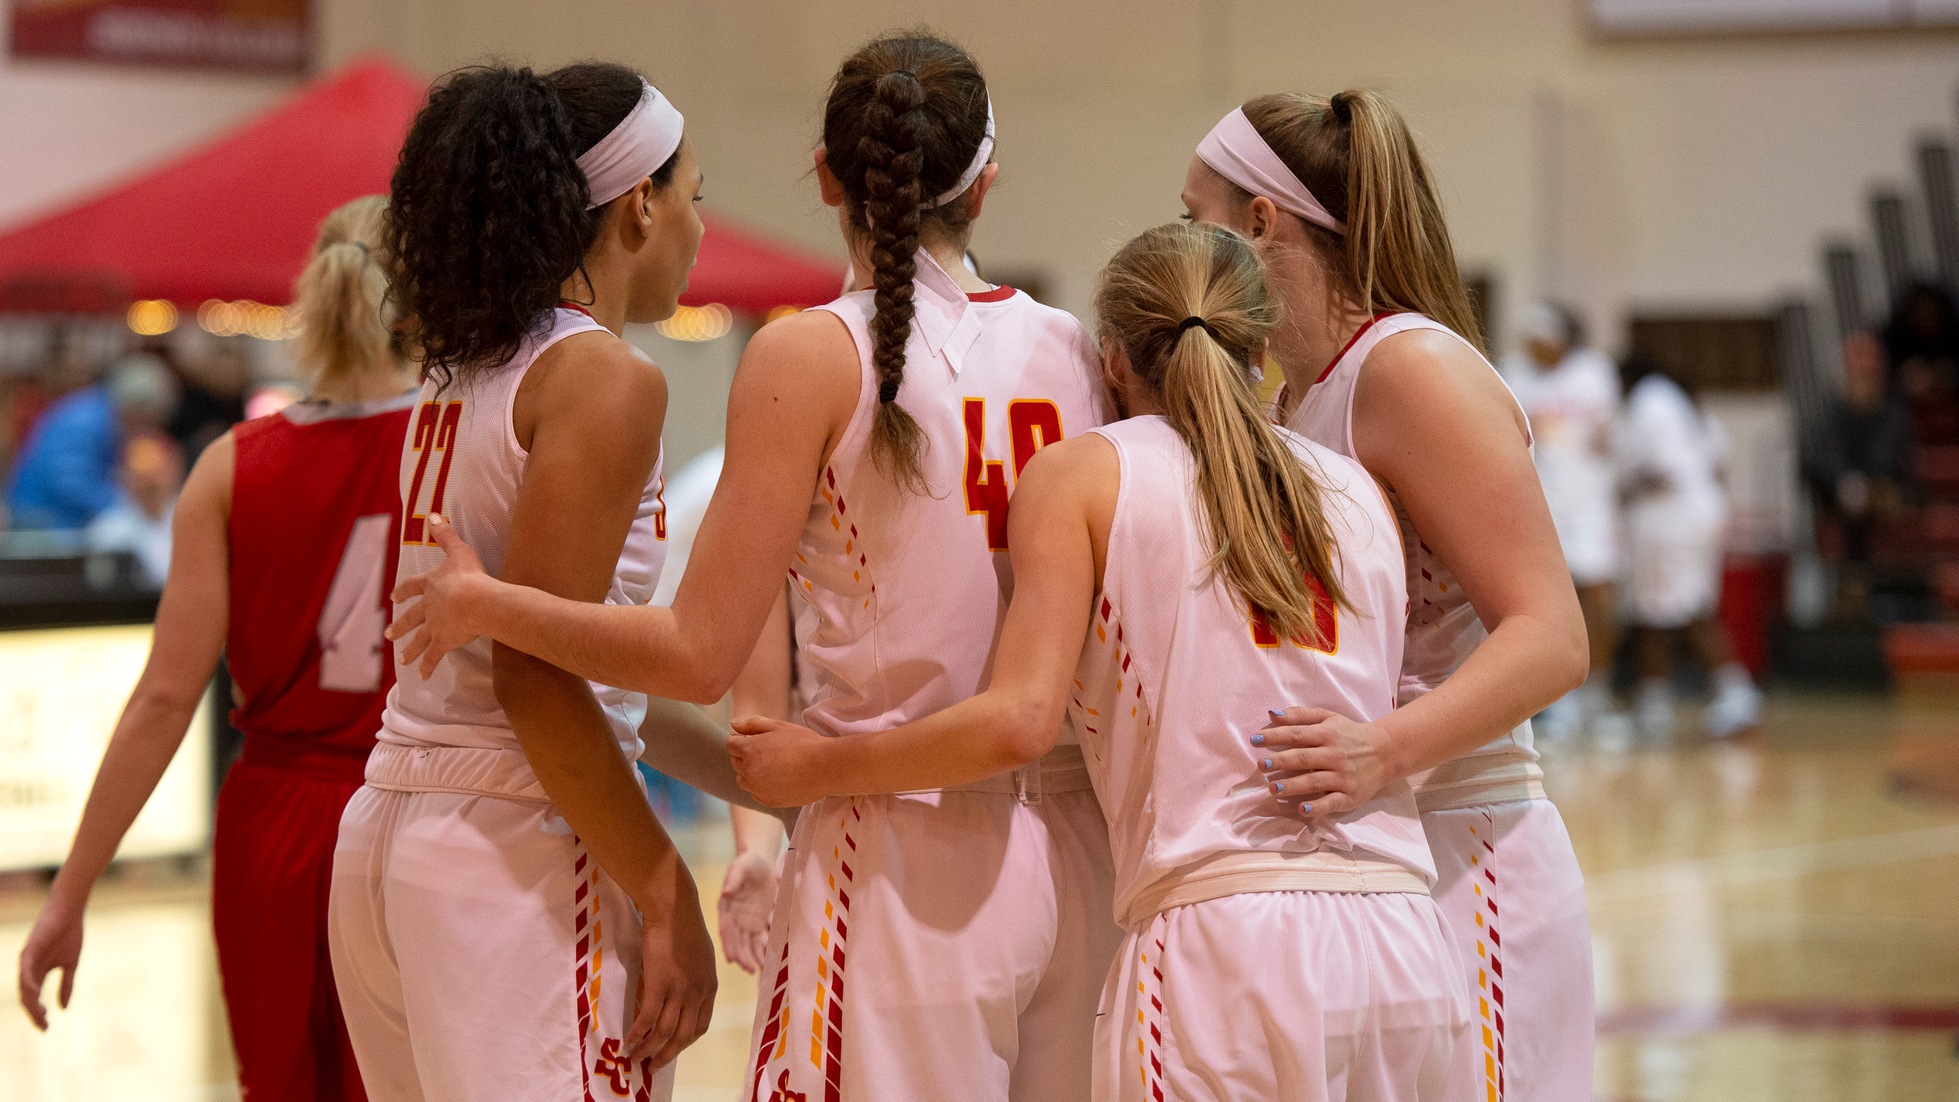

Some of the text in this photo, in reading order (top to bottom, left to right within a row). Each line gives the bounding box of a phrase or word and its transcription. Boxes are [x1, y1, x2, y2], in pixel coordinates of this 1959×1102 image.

[402, 400, 463, 547] 22
[316, 513, 392, 692] 4
[594, 1037, 632, 1098] SC
[767, 1068, 808, 1102] S
